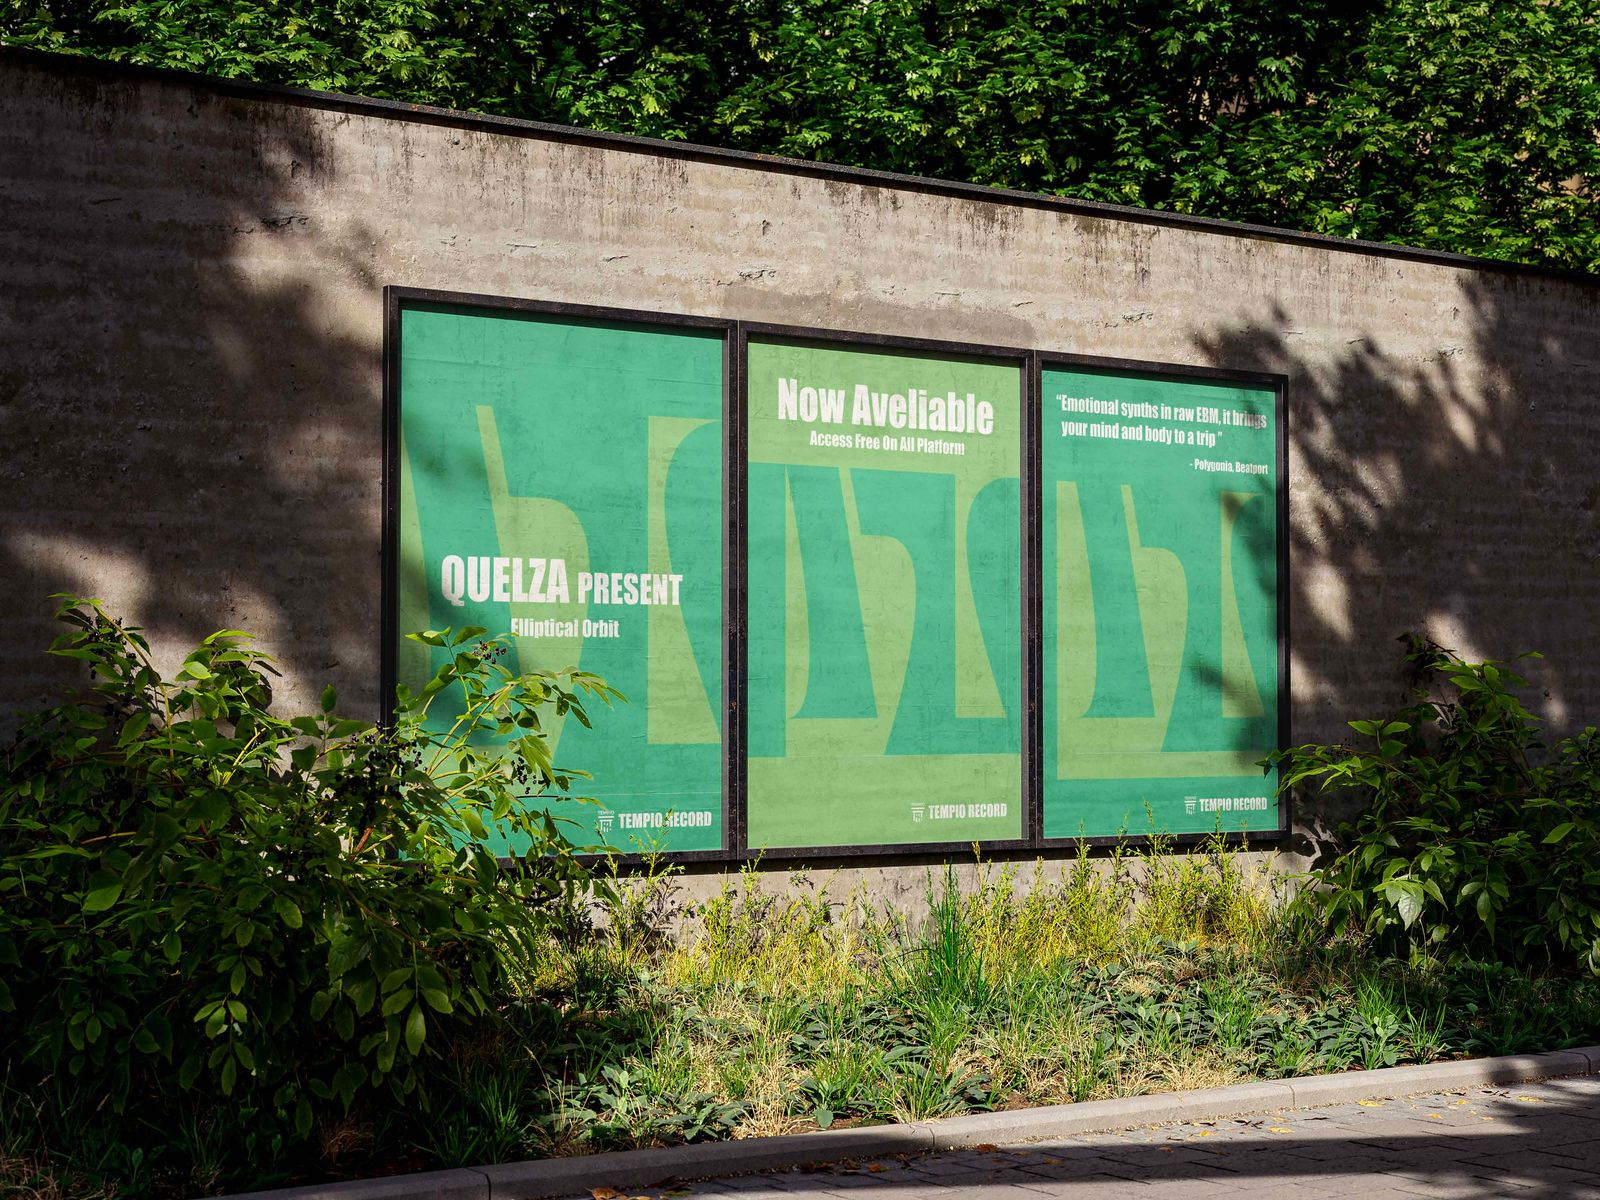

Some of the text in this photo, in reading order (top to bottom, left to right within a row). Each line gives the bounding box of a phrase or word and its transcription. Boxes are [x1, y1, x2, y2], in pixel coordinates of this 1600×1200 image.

[778, 377, 994, 435] Now Aveliable
[1121, 401, 1159, 419] synths
[1160, 403, 1172, 420] in
[1174, 407, 1194, 422] raw
[1196, 406, 1222, 426] EBM,
[1223, 409, 1231, 425] it
[1232, 410, 1267, 429] brings
[810, 430, 965, 456] Access Free On All Platform
[1061, 420, 1088, 437] your
[1090, 421, 1120, 439] mind
[1121, 425, 1143, 441] and
[1145, 425, 1172, 445] body
[1174, 428, 1185, 444] to
[1187, 430, 1195, 445] a
[1194, 458, 1234, 473] Polygonia,
[1235, 461, 1268, 475] Beatport
[441, 554, 683, 607] QUELZA PRESENT
[511, 618, 620, 638] Elliptical Orbit
[928, 802, 1008, 820] TEMPIO RECORD
[1199, 797, 1268, 812] TEMPIO RECORD
[618, 812, 663, 829] TEMPIO
